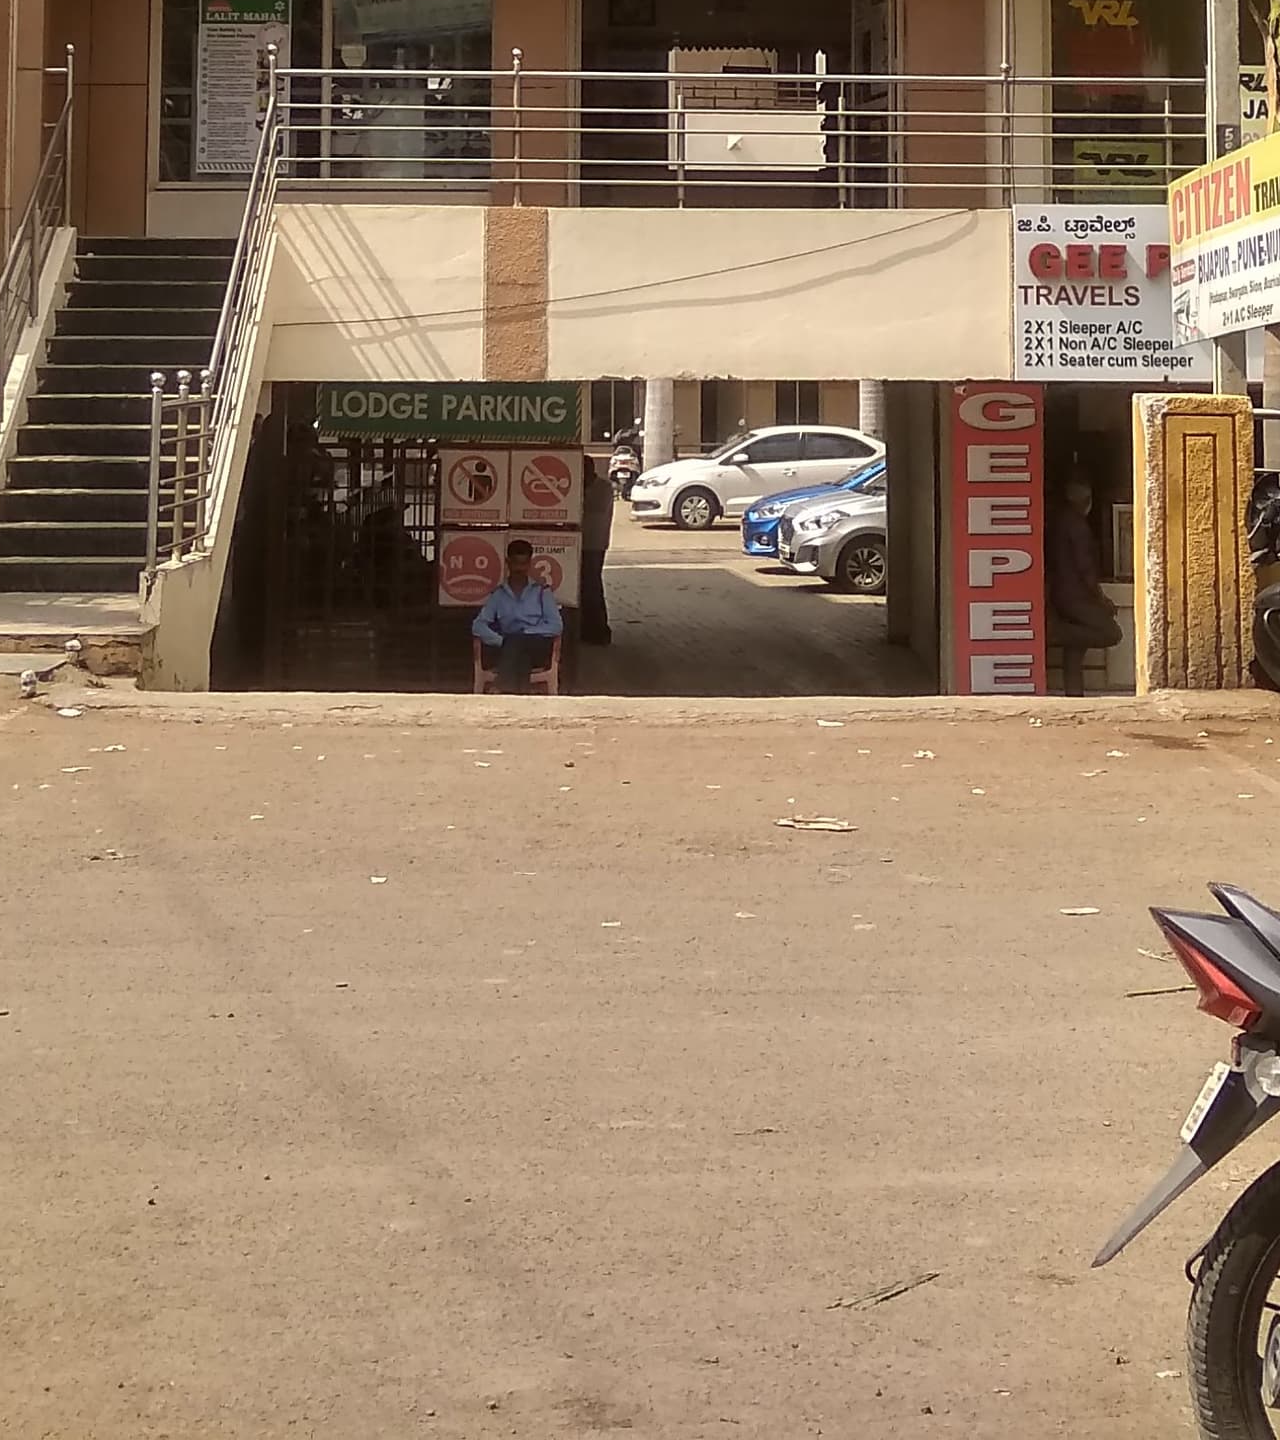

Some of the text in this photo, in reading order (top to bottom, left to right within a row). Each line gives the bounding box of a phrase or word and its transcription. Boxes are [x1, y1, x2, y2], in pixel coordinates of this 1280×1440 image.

[206, 12, 284, 21] LALIT MAHAL
[1171, 157, 1251, 246] CITIZEN
[1028, 243, 1128, 280] GEE
[1197, 245, 1231, 286] BIJAPUR
[1019, 284, 1141, 307] TRAVELS
[1247, 302, 1274, 323] Sleeper
[1059, 320, 1113, 337] Sleeper
[1116, 320, 1143, 335] A/C
[1059, 337, 1088, 351] Non
[1091, 336, 1118, 351] A/C
[1059, 353, 1106, 368] Seater
[1107, 356, 1138, 368] cum
[1141, 354, 1194, 370] Sleeper
[330, 390, 568, 424] LODGE PARKING
